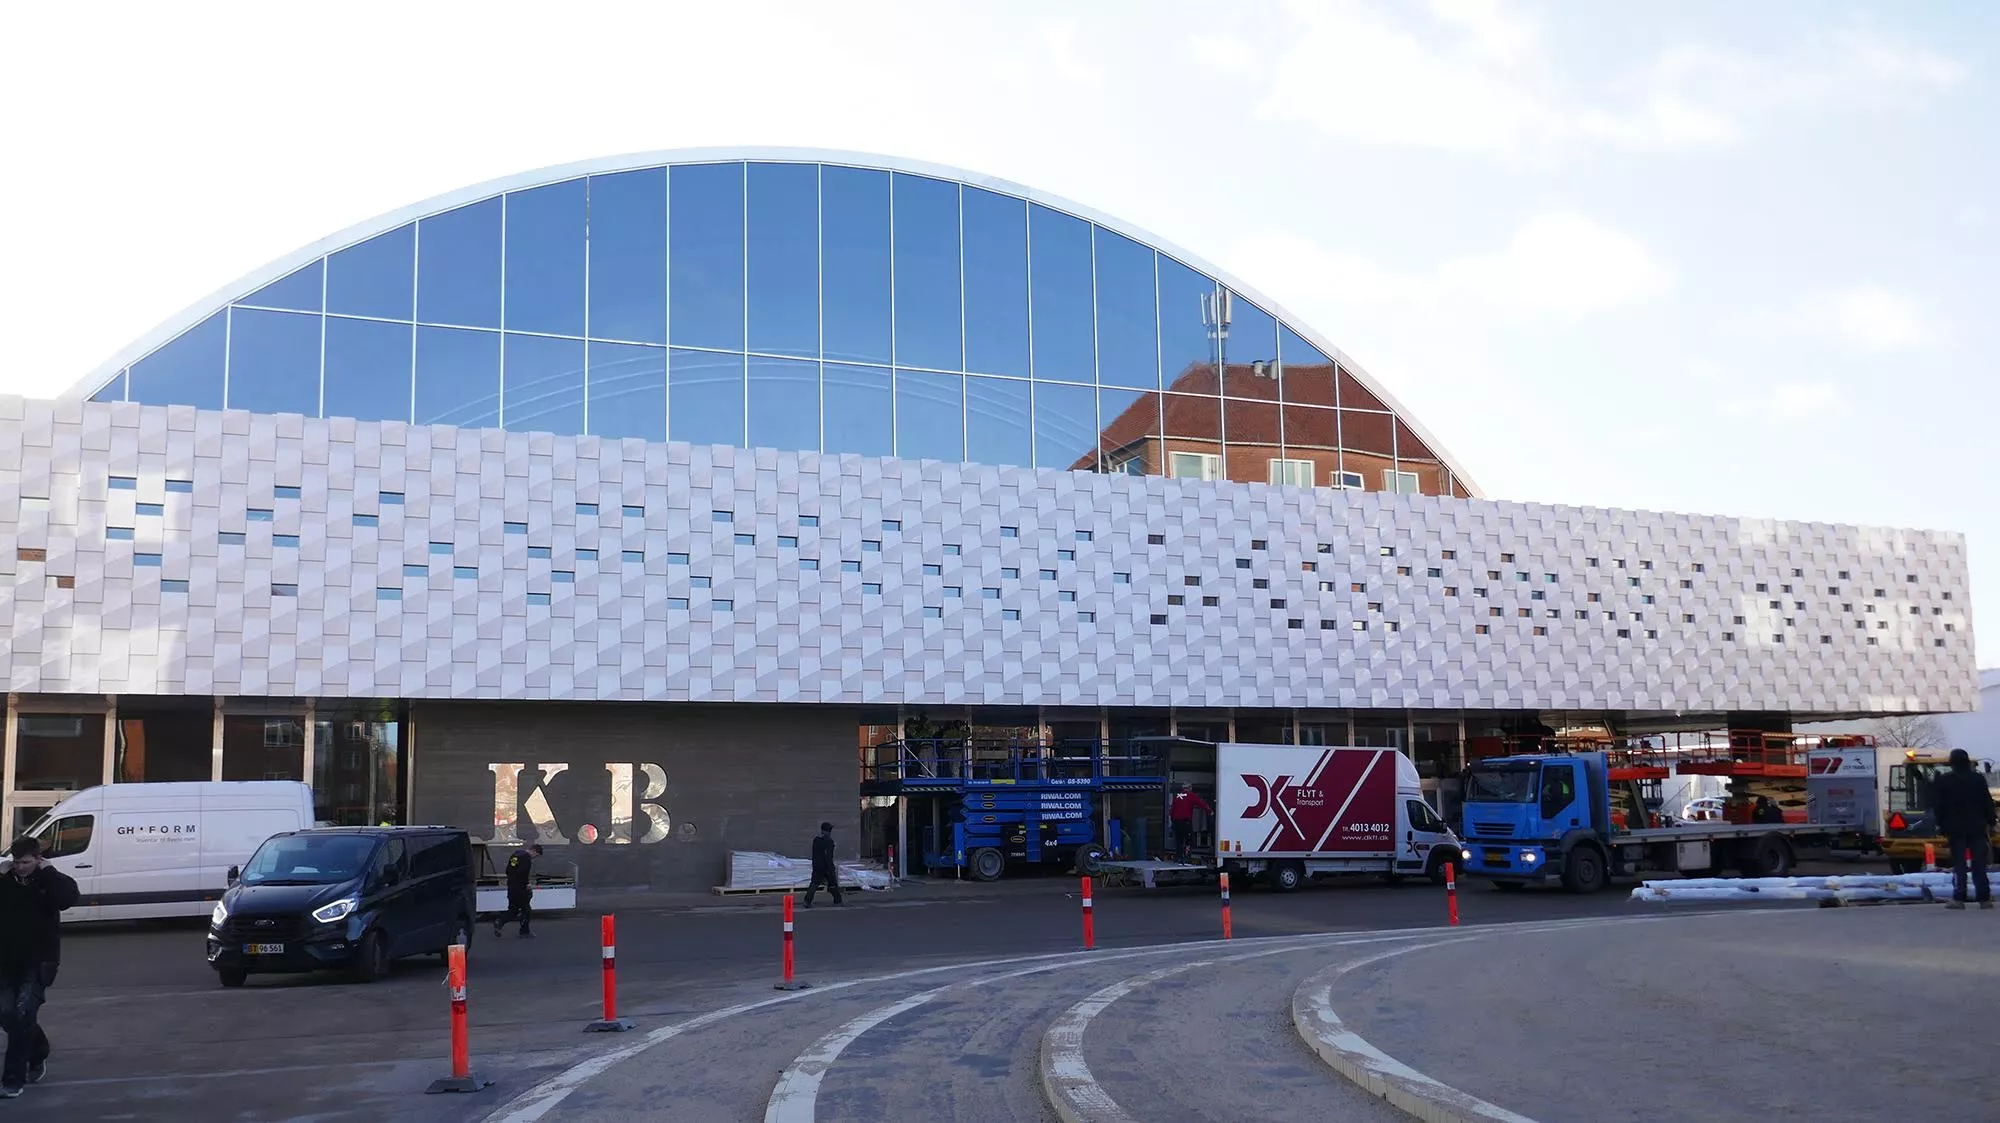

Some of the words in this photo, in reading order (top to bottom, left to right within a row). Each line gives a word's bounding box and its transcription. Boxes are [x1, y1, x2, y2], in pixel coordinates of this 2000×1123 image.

[1297, 789, 1317, 798] FLYT
[487, 763, 697, 845] K.B.
[1350, 823, 1369, 832] 4013
[1370, 823, 1390, 832] 4012
